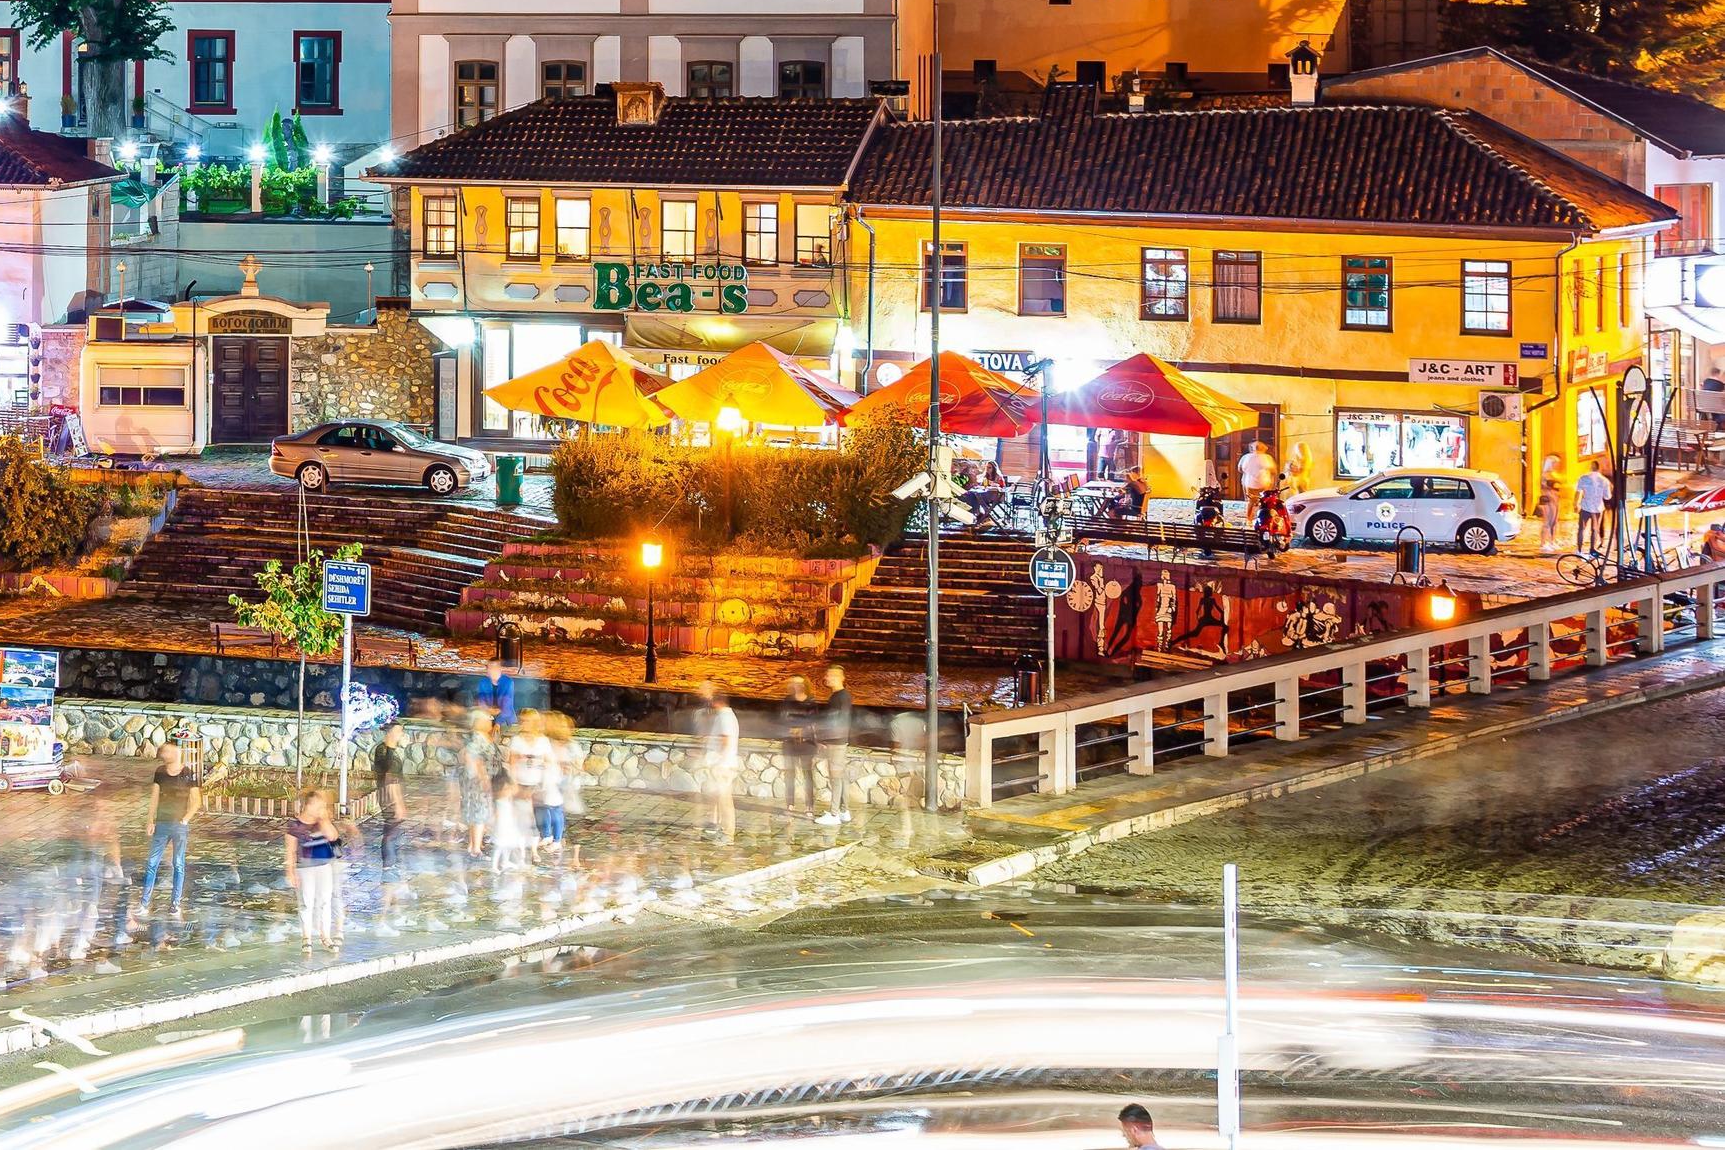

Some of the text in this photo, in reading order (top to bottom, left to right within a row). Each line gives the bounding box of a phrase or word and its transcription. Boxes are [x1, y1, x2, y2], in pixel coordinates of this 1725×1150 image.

[635, 264, 748, 280] FAST FOOD
[663, 354, 689, 364] Fast
[1418, 363, 1450, 374] J&C
[1464, 365, 1495, 375] ART
